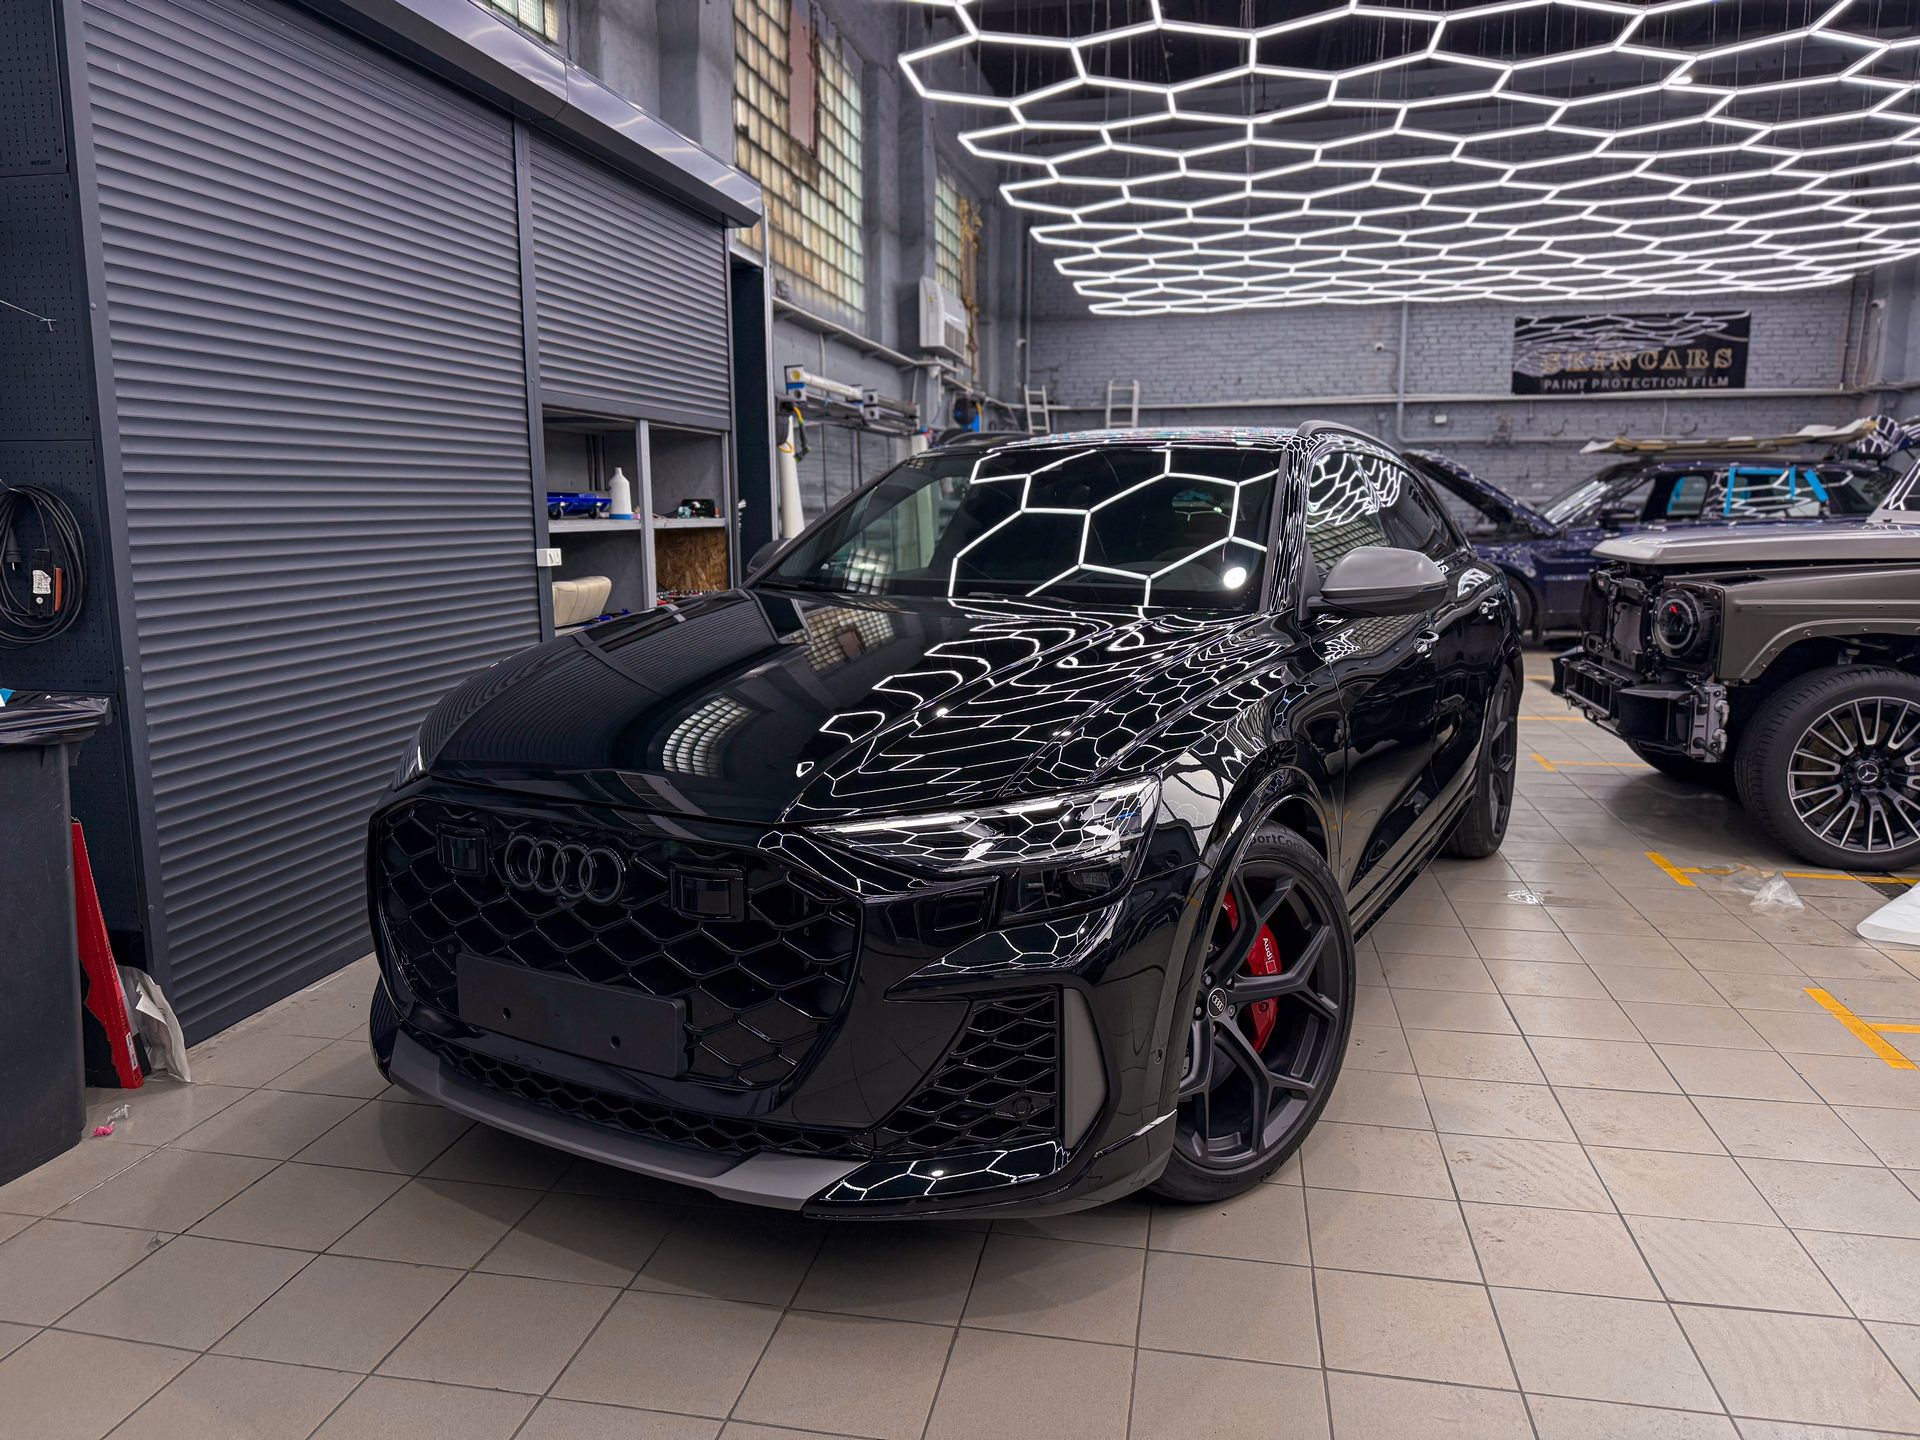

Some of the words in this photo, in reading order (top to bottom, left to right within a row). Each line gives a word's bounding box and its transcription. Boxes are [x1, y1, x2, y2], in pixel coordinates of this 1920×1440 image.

[1543, 347, 1733, 373] SKINCARS
[1543, 378, 1587, 390] PAINT
[1591, 376, 1688, 389] PROTECTION
[1692, 376, 1729, 387] FILM
[1263, 937, 1273, 960] Audi
